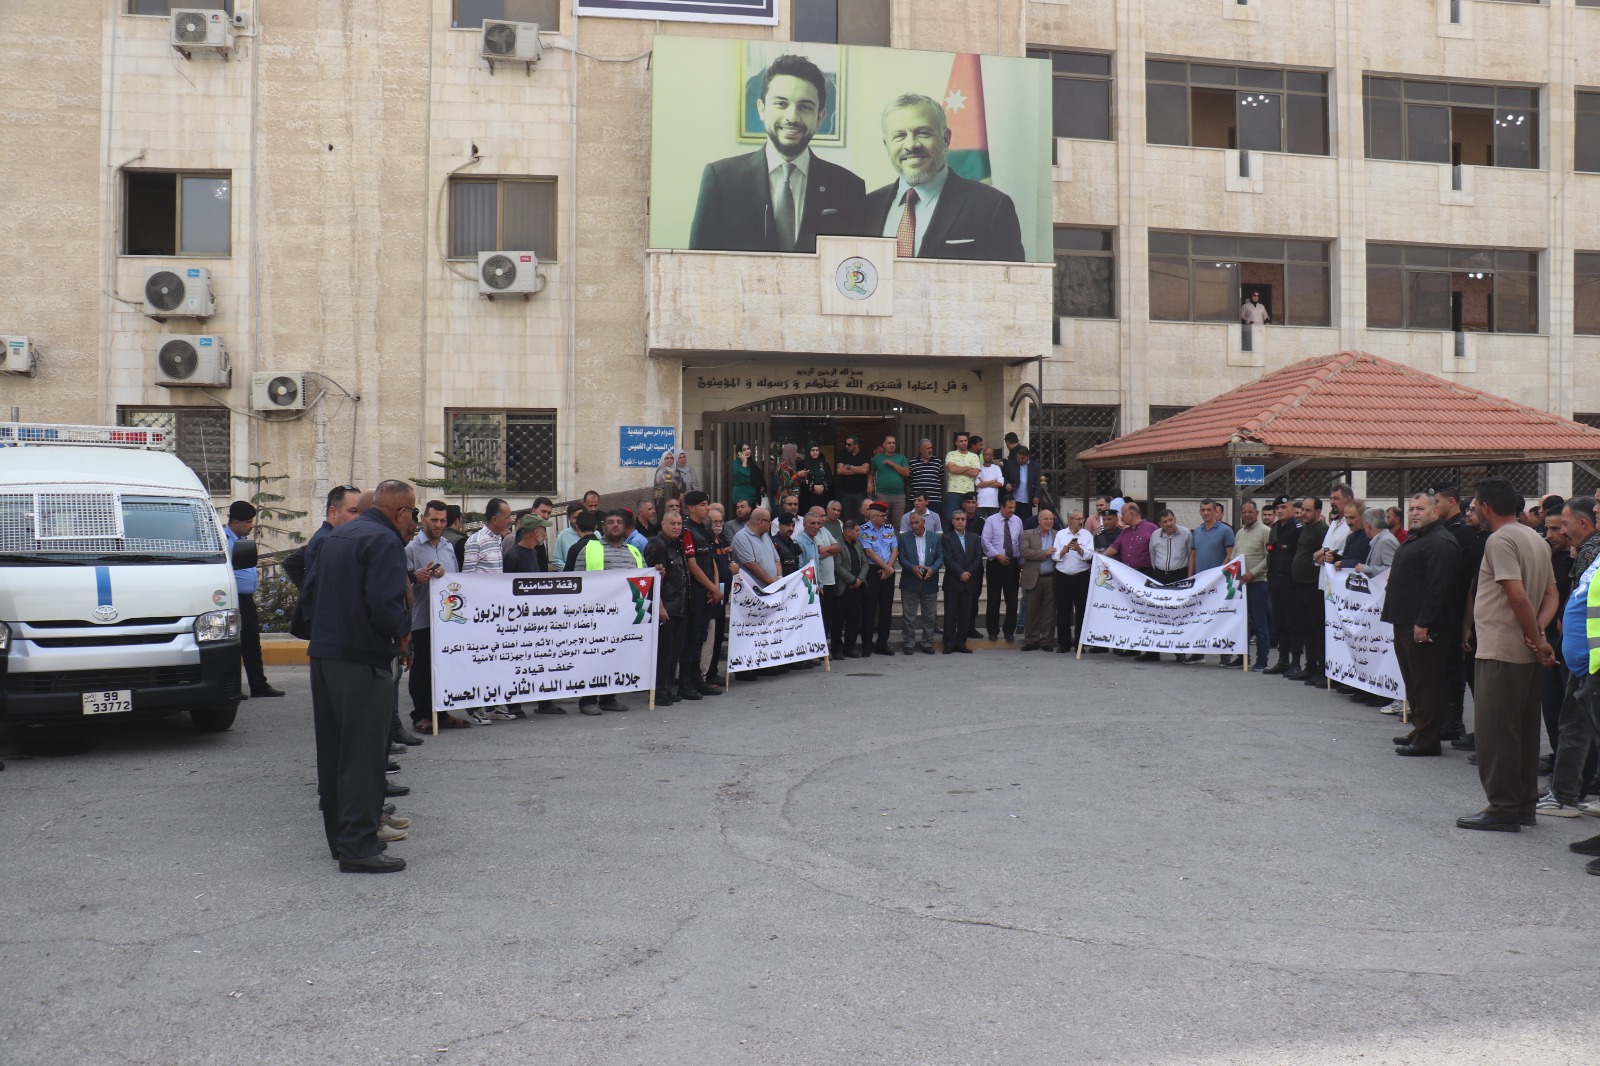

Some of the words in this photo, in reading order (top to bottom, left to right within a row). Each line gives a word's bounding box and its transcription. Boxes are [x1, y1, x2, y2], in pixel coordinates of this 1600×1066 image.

[517, 580, 553, 592] تضامنية
[555, 579, 578, 591] وقفة
[473, 604, 505, 624] الزبون
[507, 602, 530, 621] فلاح
[532, 604, 558, 617] محمد
[583, 603, 595, 617] بلدية
[595, 602, 606, 616] لجنة
[607, 602, 619, 615] رئيس
[496, 624, 521, 635] البلدية
[523, 623, 548, 634] وموظفو
[550, 621, 571, 632] اللجنة
[573, 619, 597, 631] وأعضاء
[589, 635, 609, 645] العمل
[610, 633, 644, 643] يستنكرون
[1086, 630, 1115, 644] الحسين
[1115, 636, 1130, 647] ابن
[1129, 635, 1154, 649] الثاني
[441, 644, 465, 654] الكرك
[466, 643, 489, 652] مدينة
[490, 641, 500, 652] في
[502, 639, 518, 649] أهلنا
[1175, 640, 1191, 651] عبد
[1193, 639, 1210, 648] الملك
[1212, 637, 1236, 651] جلالة
[499, 651, 532, 662] وأجهزتنا
[533, 649, 557, 659] وشعبنا
[558, 649, 580, 658] الوطن
[601, 647, 617, 656] حمى
[515, 664, 545, 675] قيادة
[548, 662, 575, 672] خلف
[588, 674, 611, 689] الملك
[614, 671, 641, 688] جلالة
[504, 678, 535, 702] الثاني
[565, 679, 586, 694] عبد
[104, 692, 118, 701] 99
[443, 686, 480, 707] الحسين
[483, 684, 501, 703] ابن
[92, 701, 130, 712] 33772
